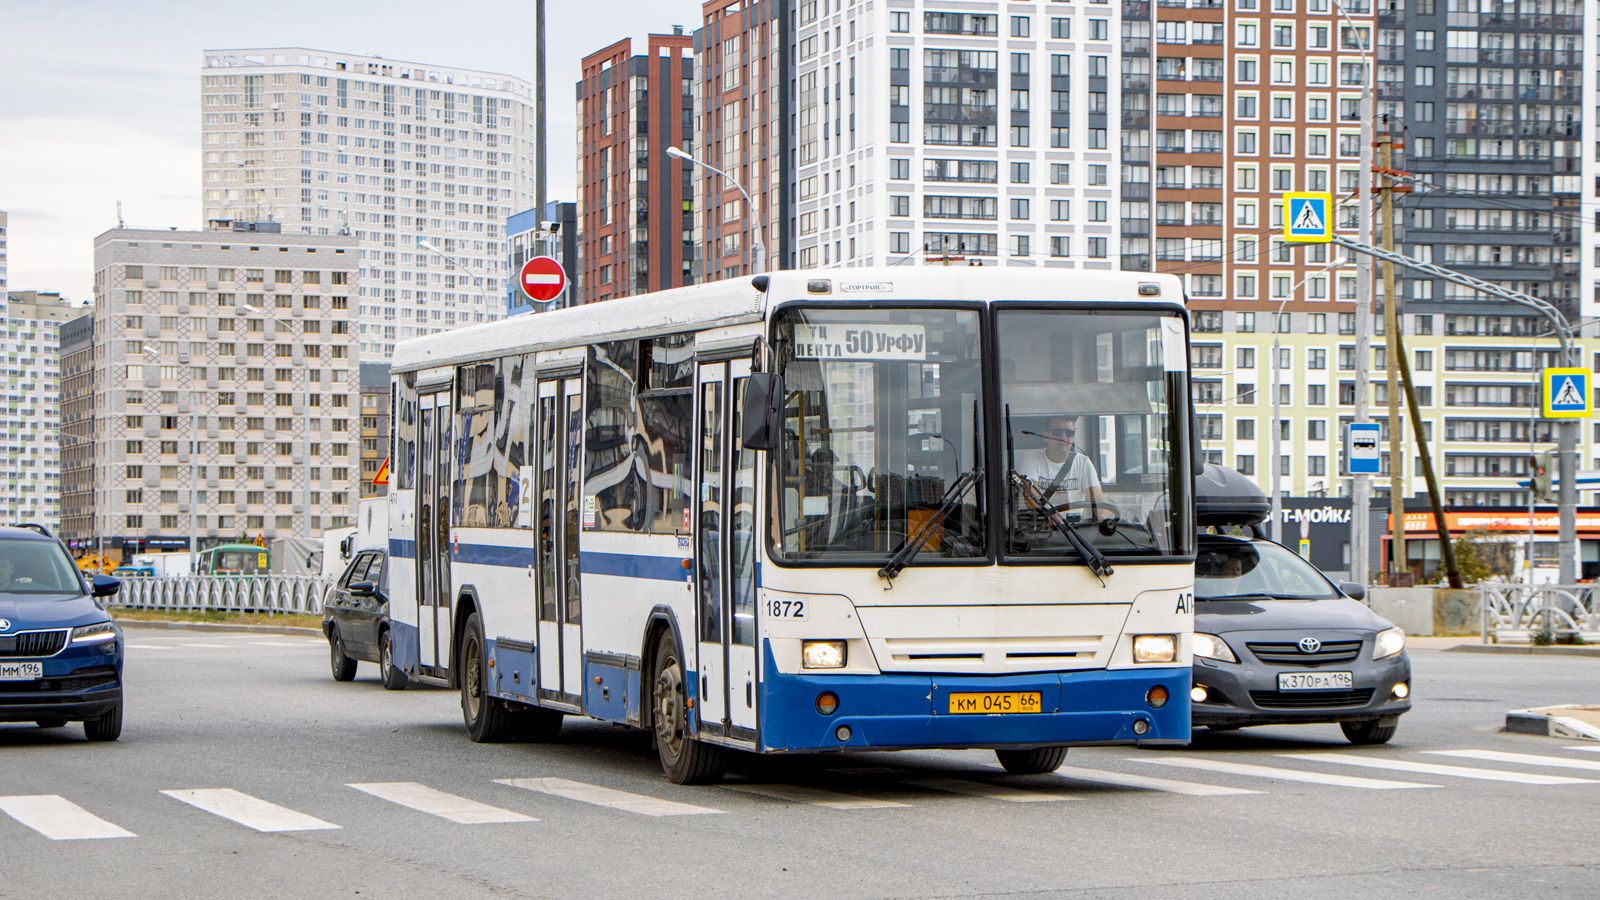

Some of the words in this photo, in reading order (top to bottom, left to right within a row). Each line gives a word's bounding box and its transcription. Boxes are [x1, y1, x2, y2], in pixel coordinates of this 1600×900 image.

[809, 326, 828, 340] ТЦ
[796, 343, 842, 356] ЛЕНТА
[845, 330, 874, 354] 50
[1263, 506, 1352, 523] Т-МОЙКА
[766, 600, 804, 617] 1872
[21, 663, 40, 672] 196
[1332, 673, 1350, 683] 196
[957, 699, 977, 710] КМ
[983, 695, 1012, 710] 045
[1020, 694, 1035, 705] 66
